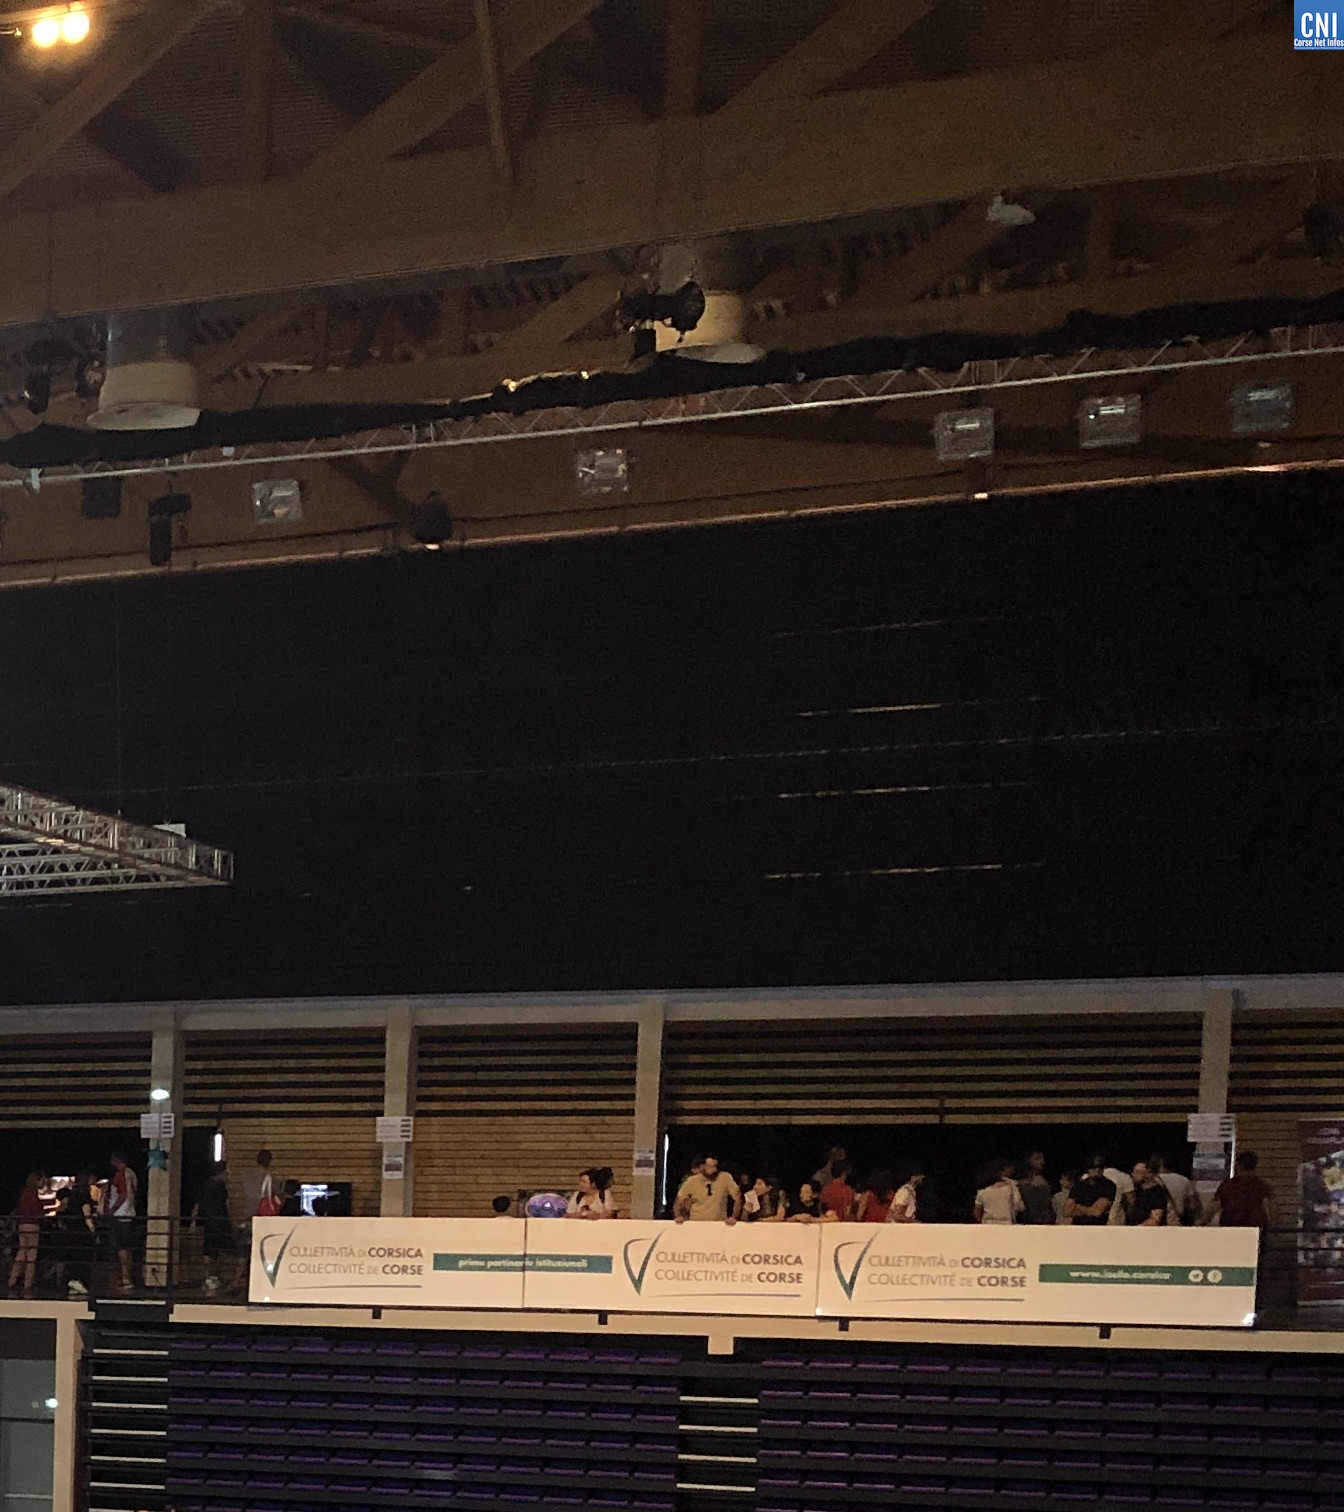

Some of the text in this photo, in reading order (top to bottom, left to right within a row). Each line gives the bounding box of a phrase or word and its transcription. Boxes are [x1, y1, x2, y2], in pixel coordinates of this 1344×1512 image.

[367, 1246, 424, 1260] CORSICA
[741, 1252, 804, 1267] CORSICA
[288, 1259, 365, 1276] COLLECTIVITÉ
[382, 1262, 424, 1277] CORSE
[961, 1256, 1027, 1270] CORSICA
[654, 1266, 739, 1283] COLLECTIVITÉ
[757, 1271, 803, 1284] CORSE
[867, 1269, 957, 1287] COLLECTIVITÉ
[977, 1275, 1028, 1288] CORSE
